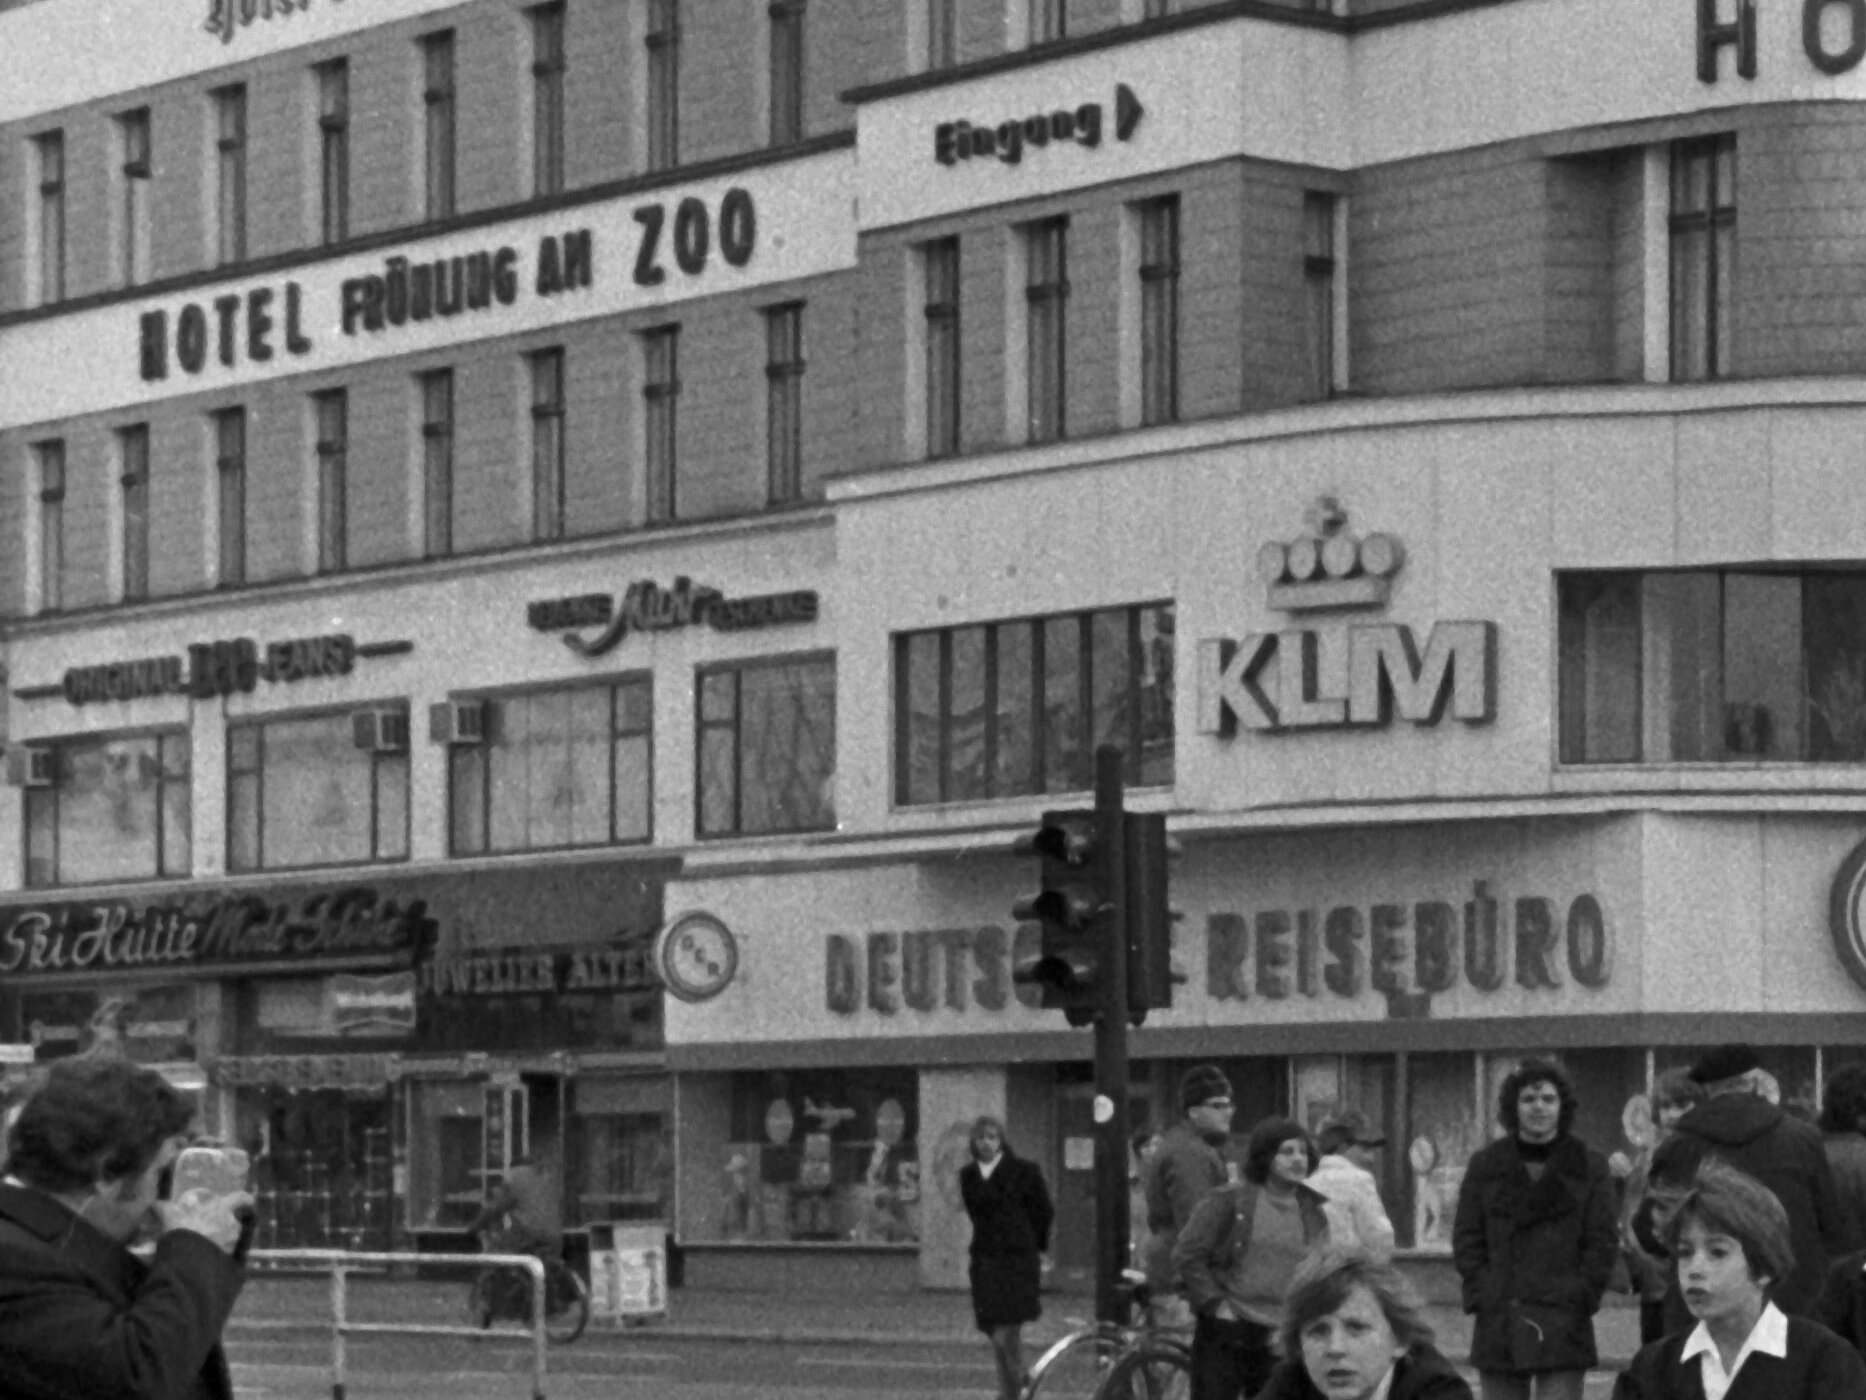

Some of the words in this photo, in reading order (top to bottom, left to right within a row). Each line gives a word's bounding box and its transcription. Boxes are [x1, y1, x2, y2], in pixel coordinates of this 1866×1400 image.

[934, 102, 1102, 167] Eingang
[139, 282, 312, 381] HOTEL
[536, 228, 593, 297] AM
[633, 187, 757, 288] ZOO
[1198, 619, 1498, 738] KLM
[825, 922, 1044, 1016] DEUTSC
[1205, 880, 1614, 1002] REISEBÜRO
